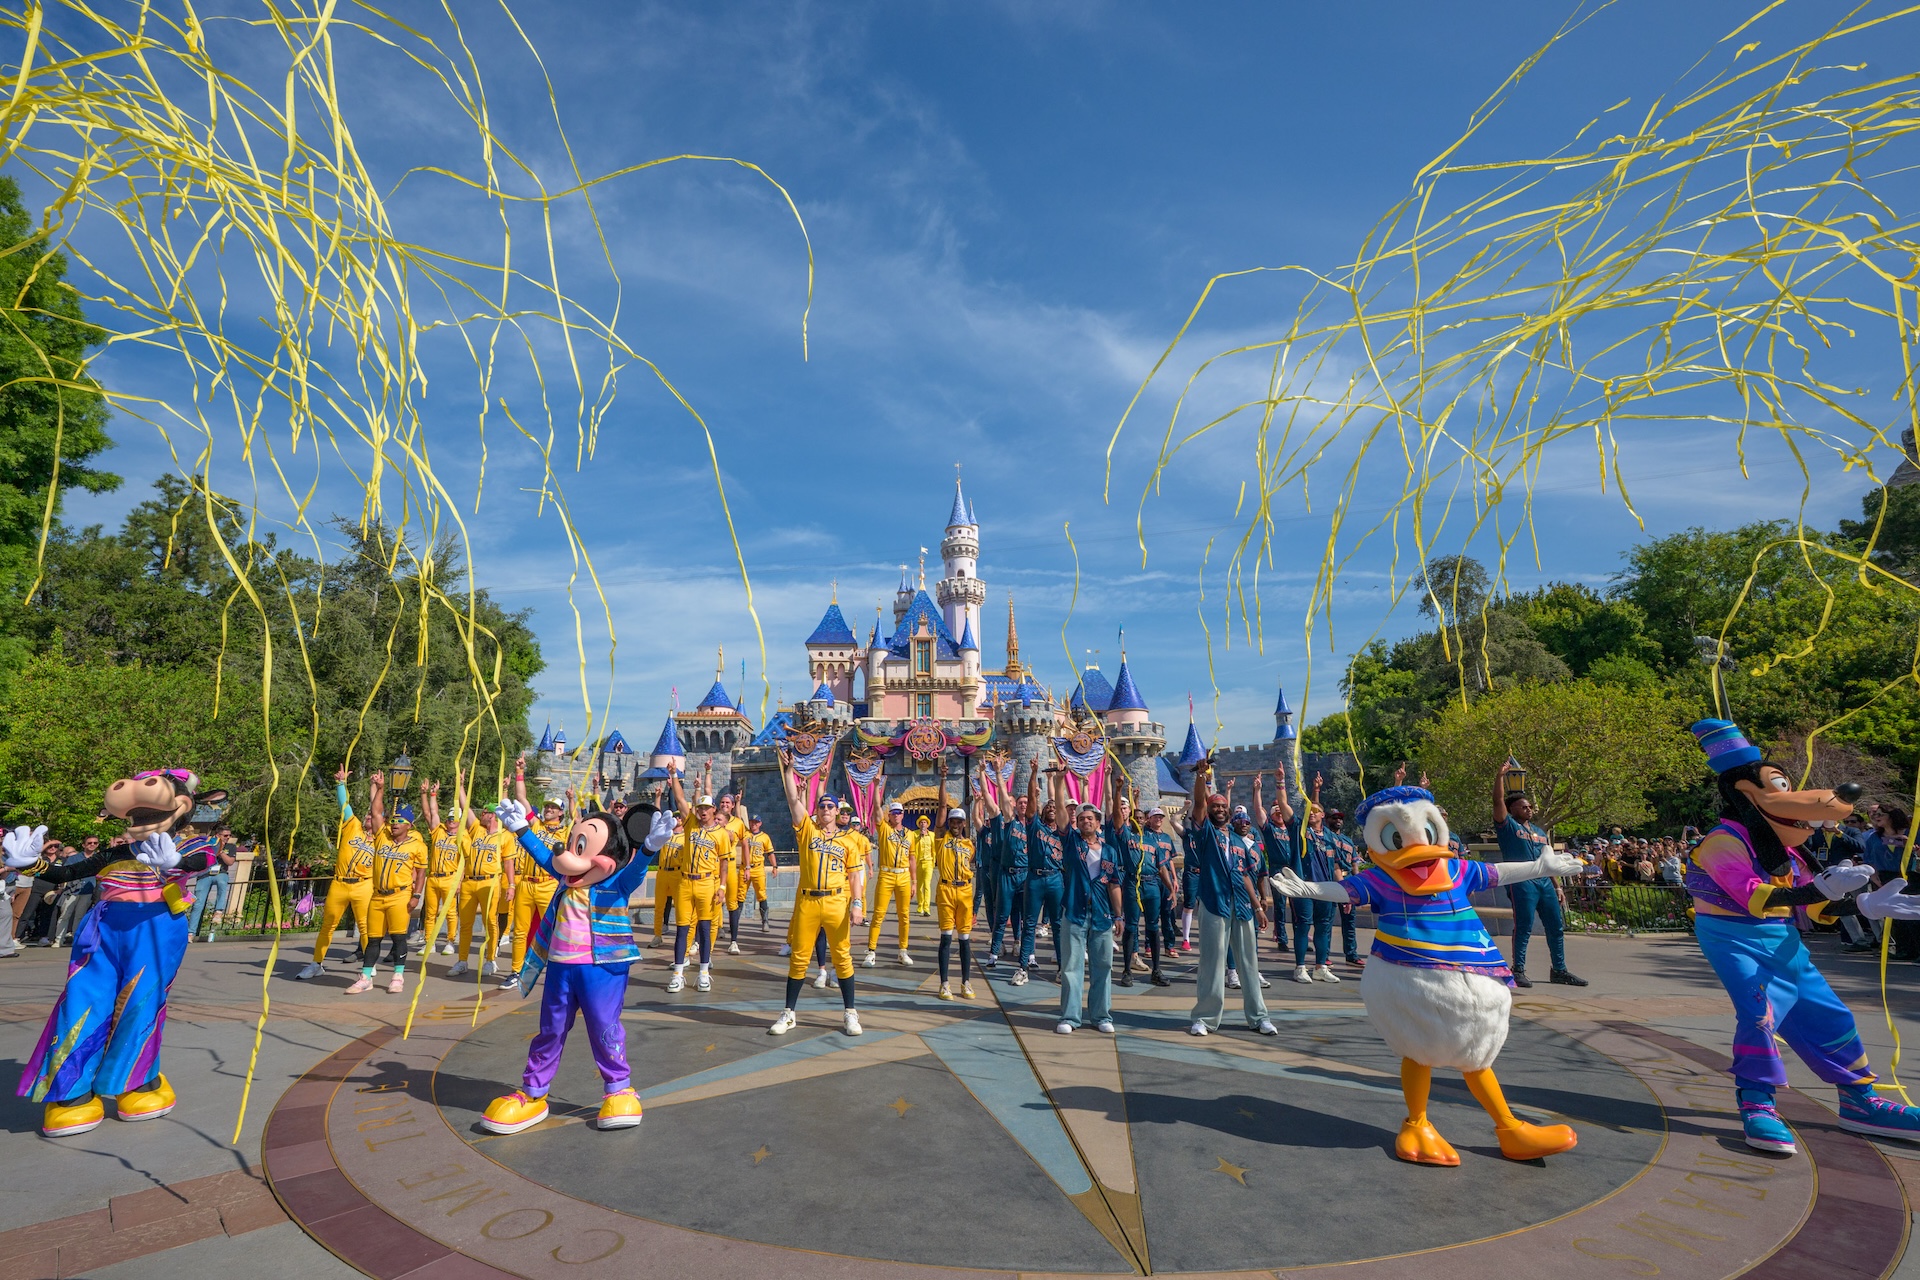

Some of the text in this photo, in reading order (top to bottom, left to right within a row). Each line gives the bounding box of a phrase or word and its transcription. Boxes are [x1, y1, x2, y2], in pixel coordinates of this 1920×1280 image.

[703, 850, 710, 860] 4
[808, 836, 845, 859] Bananas
[394, 862, 403, 873] 7
[353, 1079, 427, 1153] TRUE
[396, 1163, 626, 1266] COME
